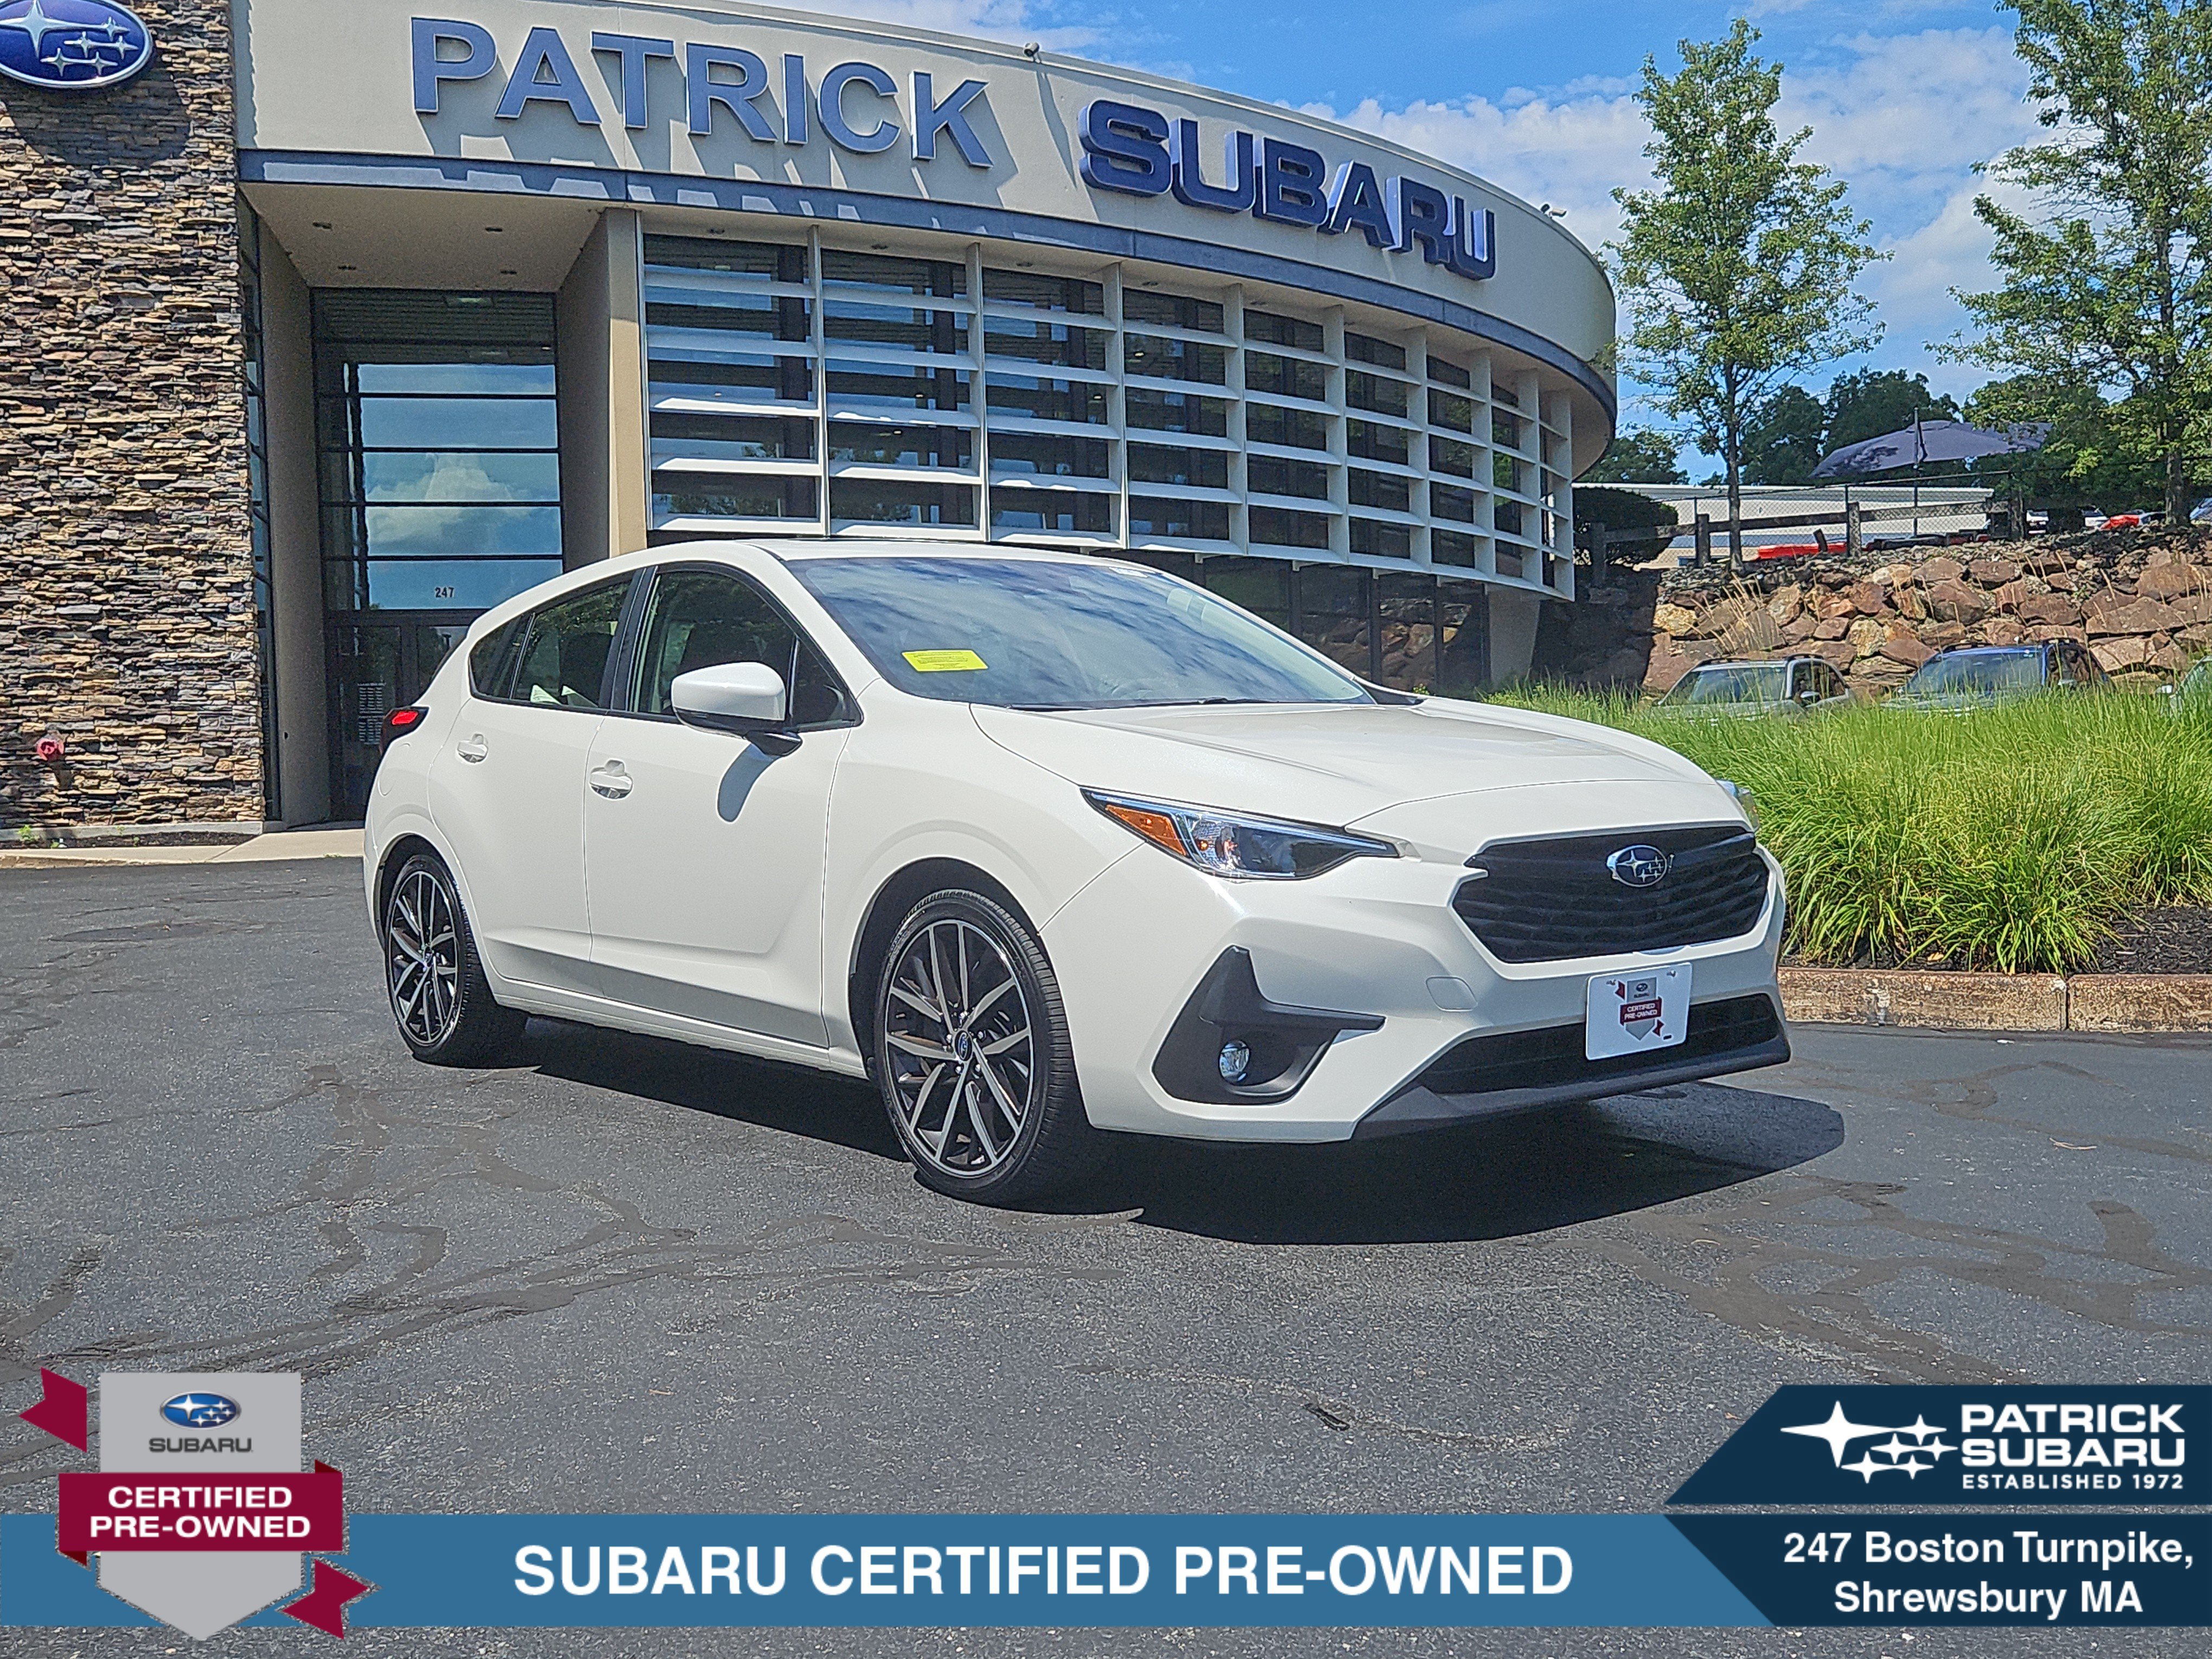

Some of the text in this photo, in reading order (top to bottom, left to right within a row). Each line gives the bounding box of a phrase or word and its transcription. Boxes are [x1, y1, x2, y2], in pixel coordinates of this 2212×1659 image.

[410, 16, 993, 168] PATRICK
[1078, 99, 1495, 281] SUBARU
[434, 587, 454, 598] 247
